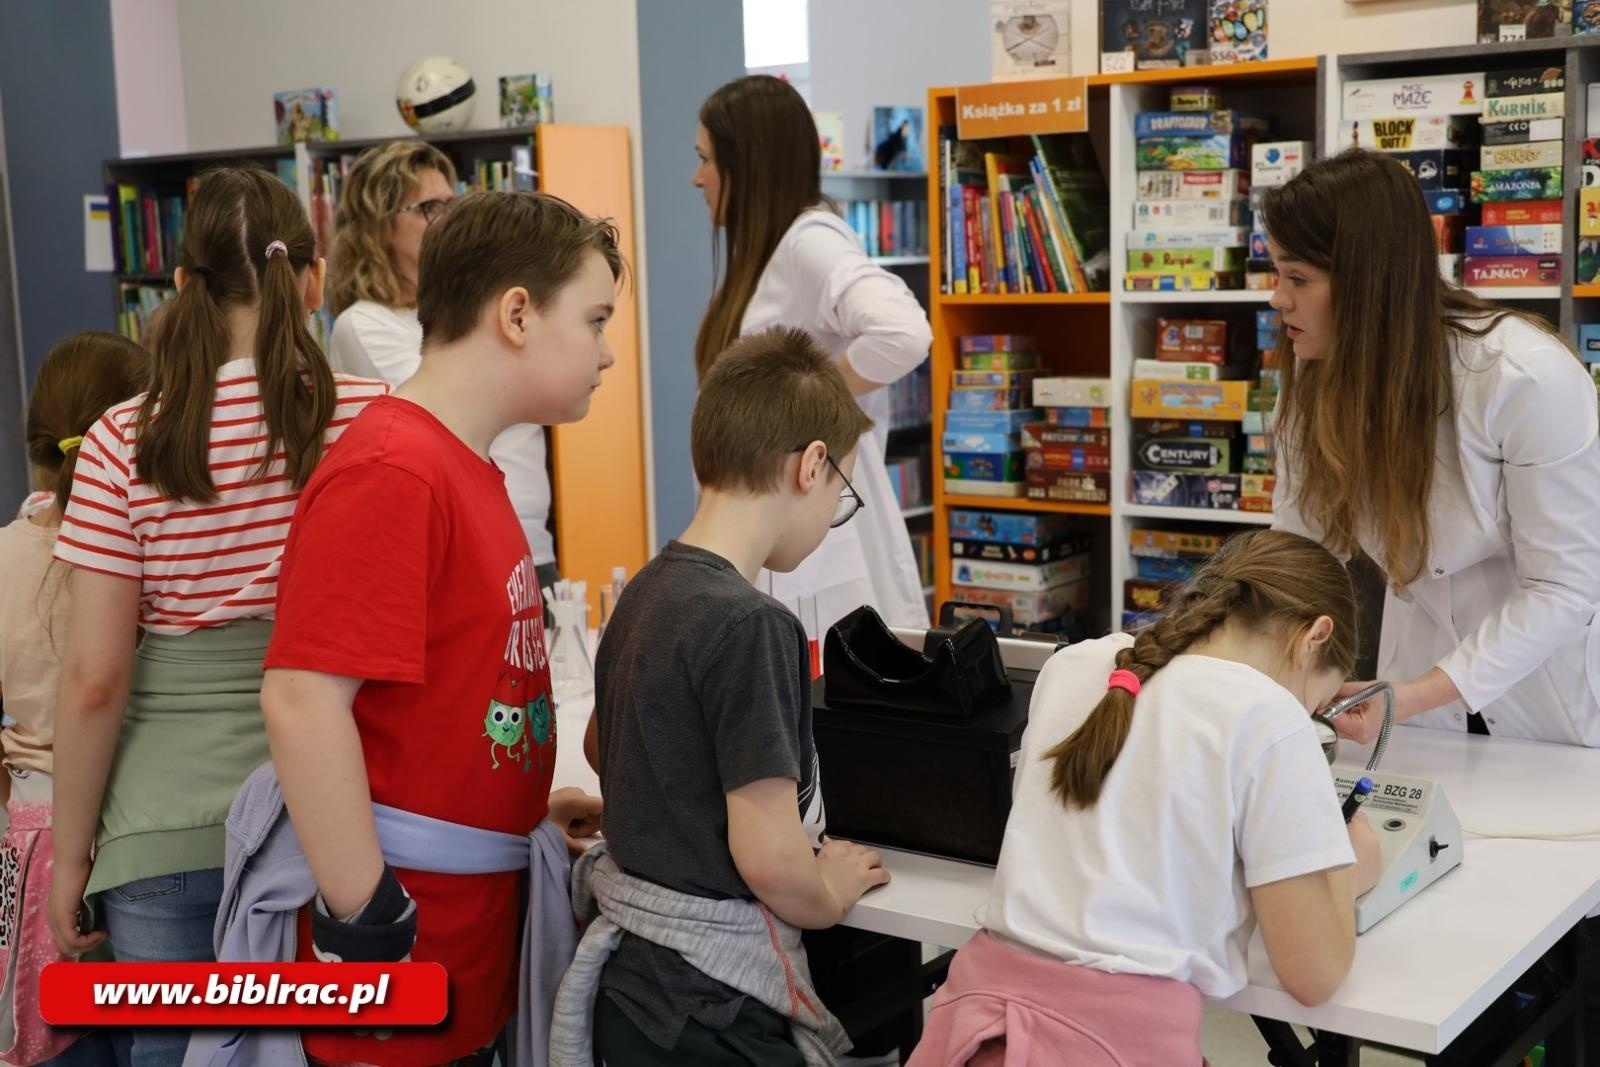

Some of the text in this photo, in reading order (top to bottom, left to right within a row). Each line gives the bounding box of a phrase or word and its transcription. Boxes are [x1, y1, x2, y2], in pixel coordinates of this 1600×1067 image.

[1393, 90, 1432, 106] MAZE
[962, 96, 1081, 121] Książka za 1 zł
[1373, 119, 1414, 137] BLOCK
[1472, 267, 1529, 280] TAJNIACY
[1147, 445, 1209, 462] CENTURY
[1384, 784, 1408, 798] BZG
[1408, 788, 1423, 800] 28
